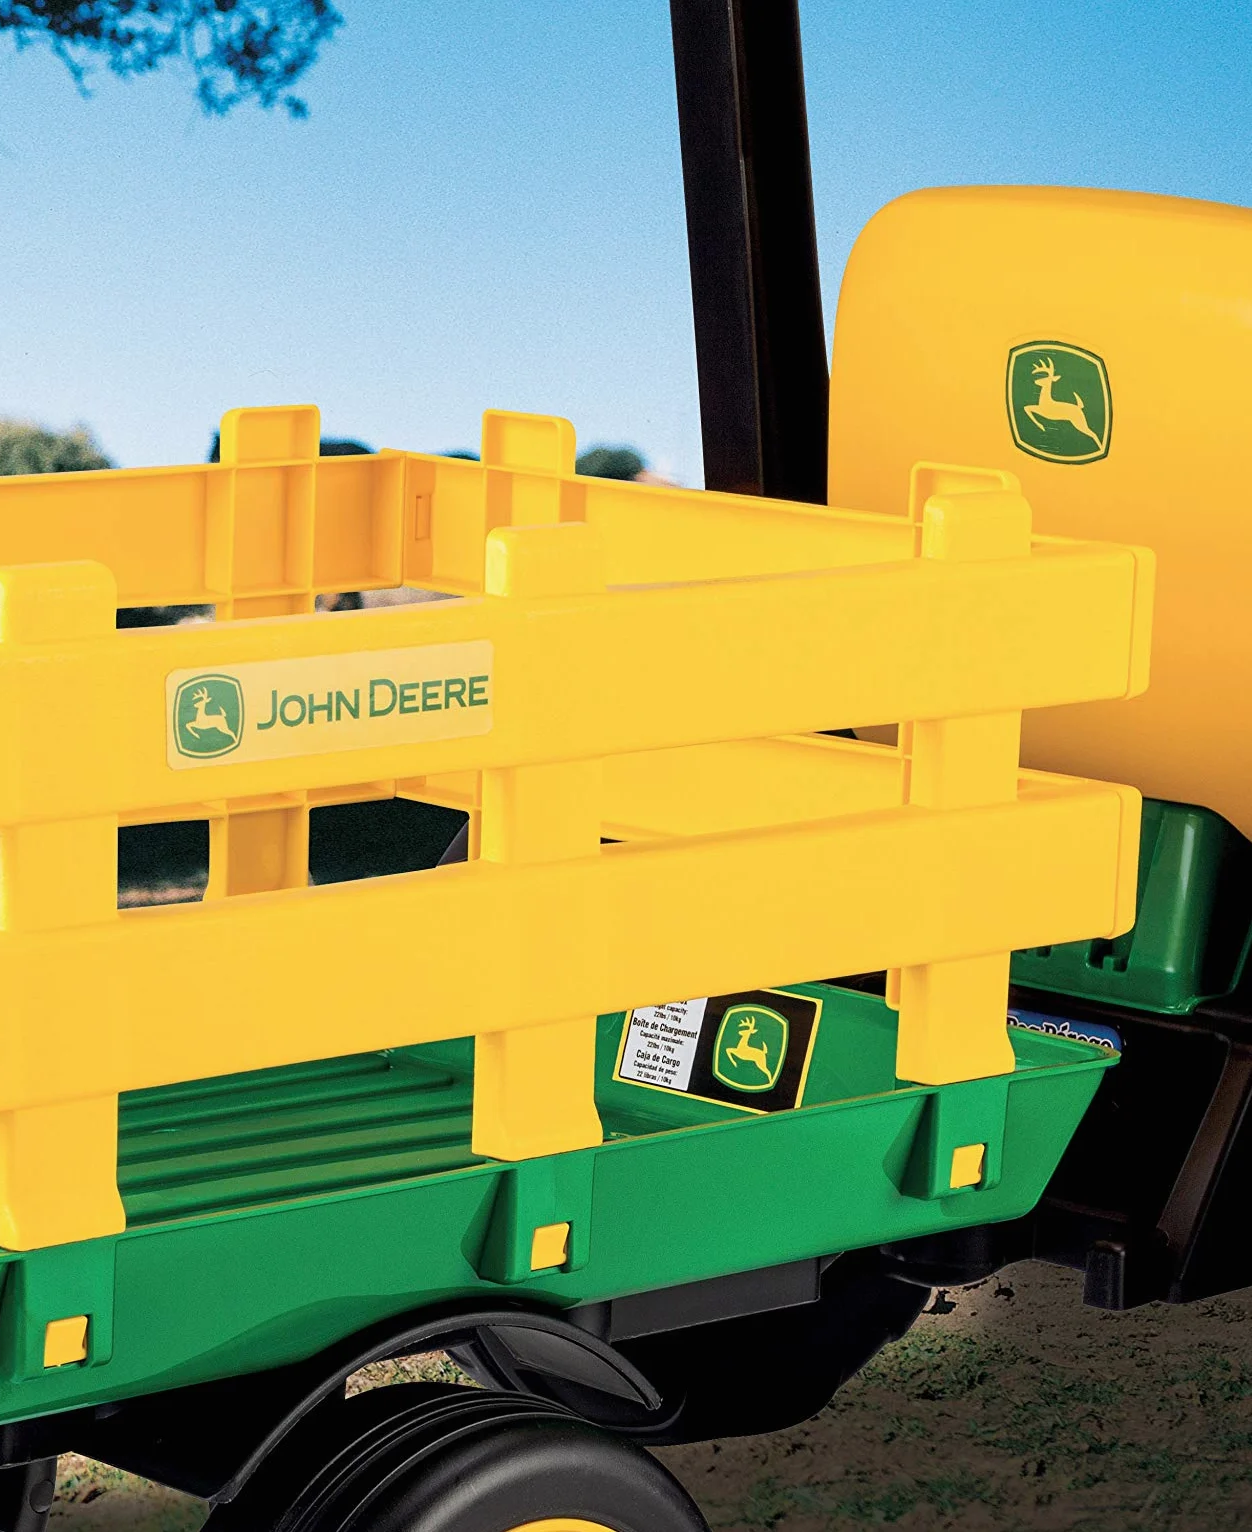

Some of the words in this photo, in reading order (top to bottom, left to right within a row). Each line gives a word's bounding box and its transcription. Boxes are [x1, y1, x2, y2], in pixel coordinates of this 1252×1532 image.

[257, 689, 360, 730] JOHN
[369, 676, 489, 717] DEERE
[671, 1015, 681, 1023] 10kg
[633, 1017, 650, 1028] Boîte
[651, 1021, 658, 1030] de
[660, 1023, 698, 1039] Chargement
[640, 1030, 660, 1039] Capacité
[664, 1045, 675, 1054] 10kg
[636, 1049, 651, 1061] Caja
[652, 1053, 660, 1062] de
[662, 1055, 680, 1068] Cargo
[633, 1060, 658, 1071] Capacidad
[665, 1068, 677, 1076] peso:
[644, 1072, 657, 1081] libras
[661, 1076, 672, 1085] 10kg
